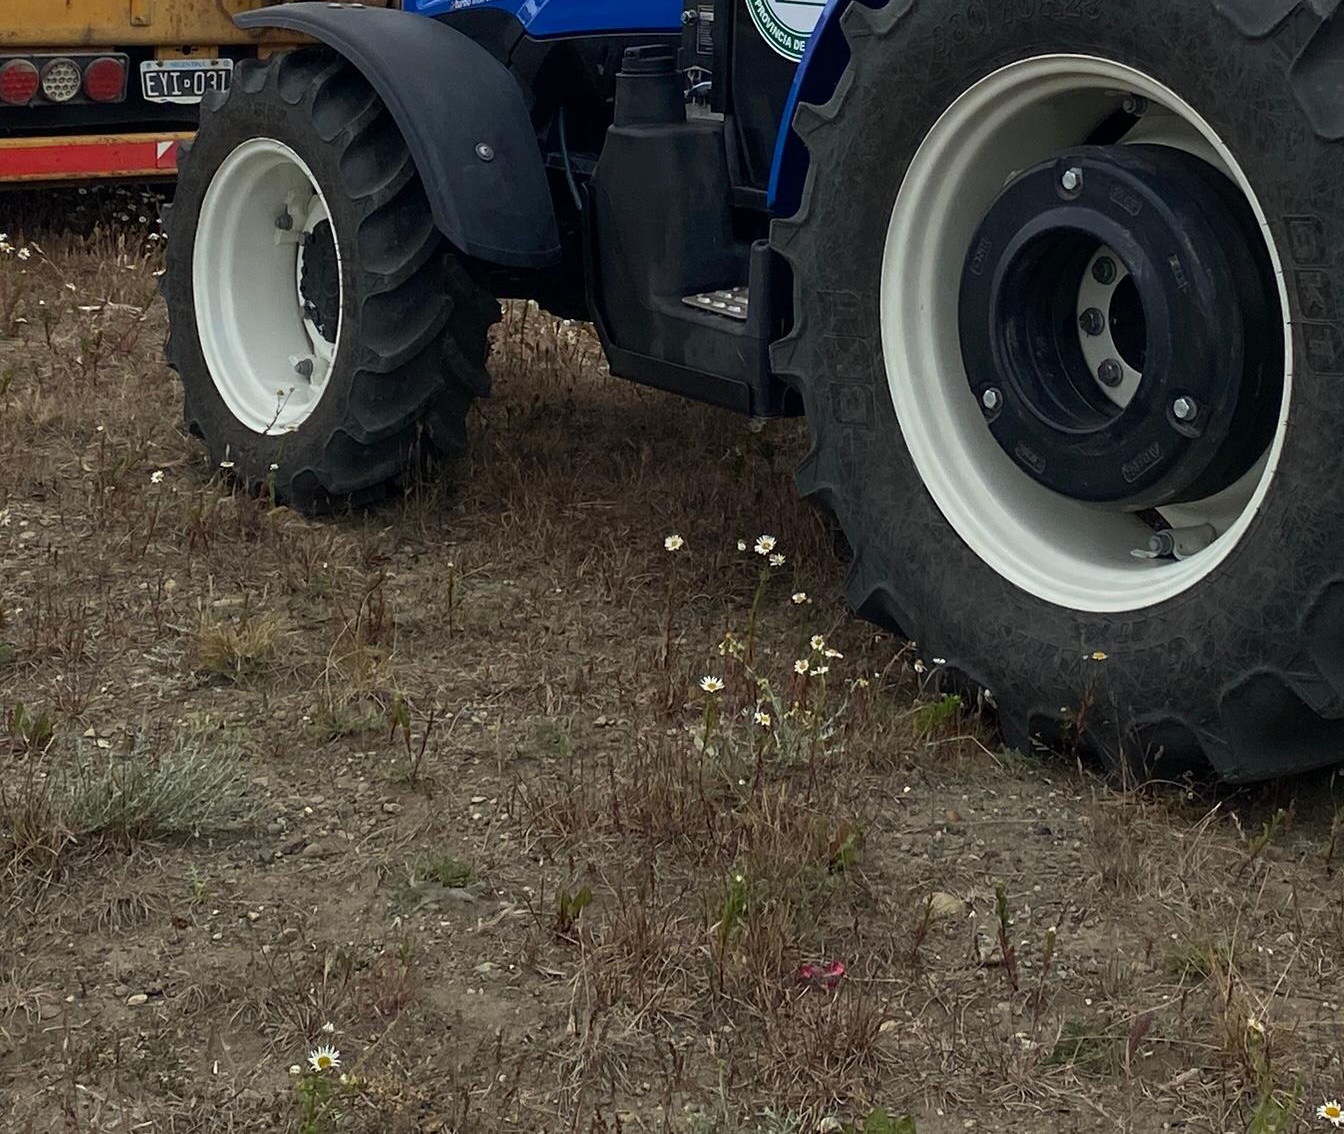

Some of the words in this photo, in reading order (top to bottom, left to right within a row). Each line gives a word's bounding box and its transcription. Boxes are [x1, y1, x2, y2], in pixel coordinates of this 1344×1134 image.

[793, 39, 806, 52] DE
[145, 72, 182, 96] EYI
[193, 70, 226, 95] 031
